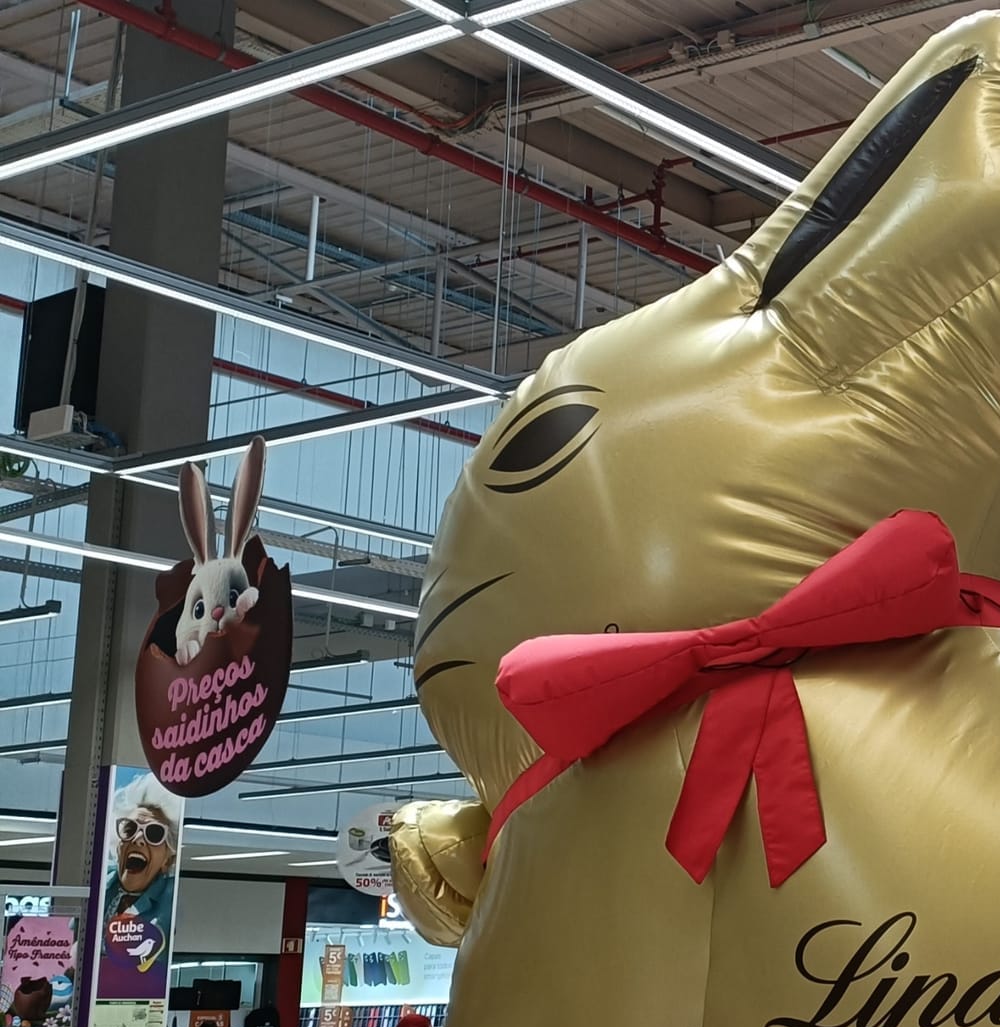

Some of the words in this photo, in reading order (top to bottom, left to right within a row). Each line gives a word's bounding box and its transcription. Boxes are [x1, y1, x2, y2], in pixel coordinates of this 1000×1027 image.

[168, 655, 255, 712] Preços
[151, 682, 268, 749] saidinhos
[160, 752, 192, 782] da
[194, 713, 266, 777] casca
[109, 921, 144, 934] Clube
[112, 933, 143, 942] Auchan
[8, 949, 29, 960] Tipo
